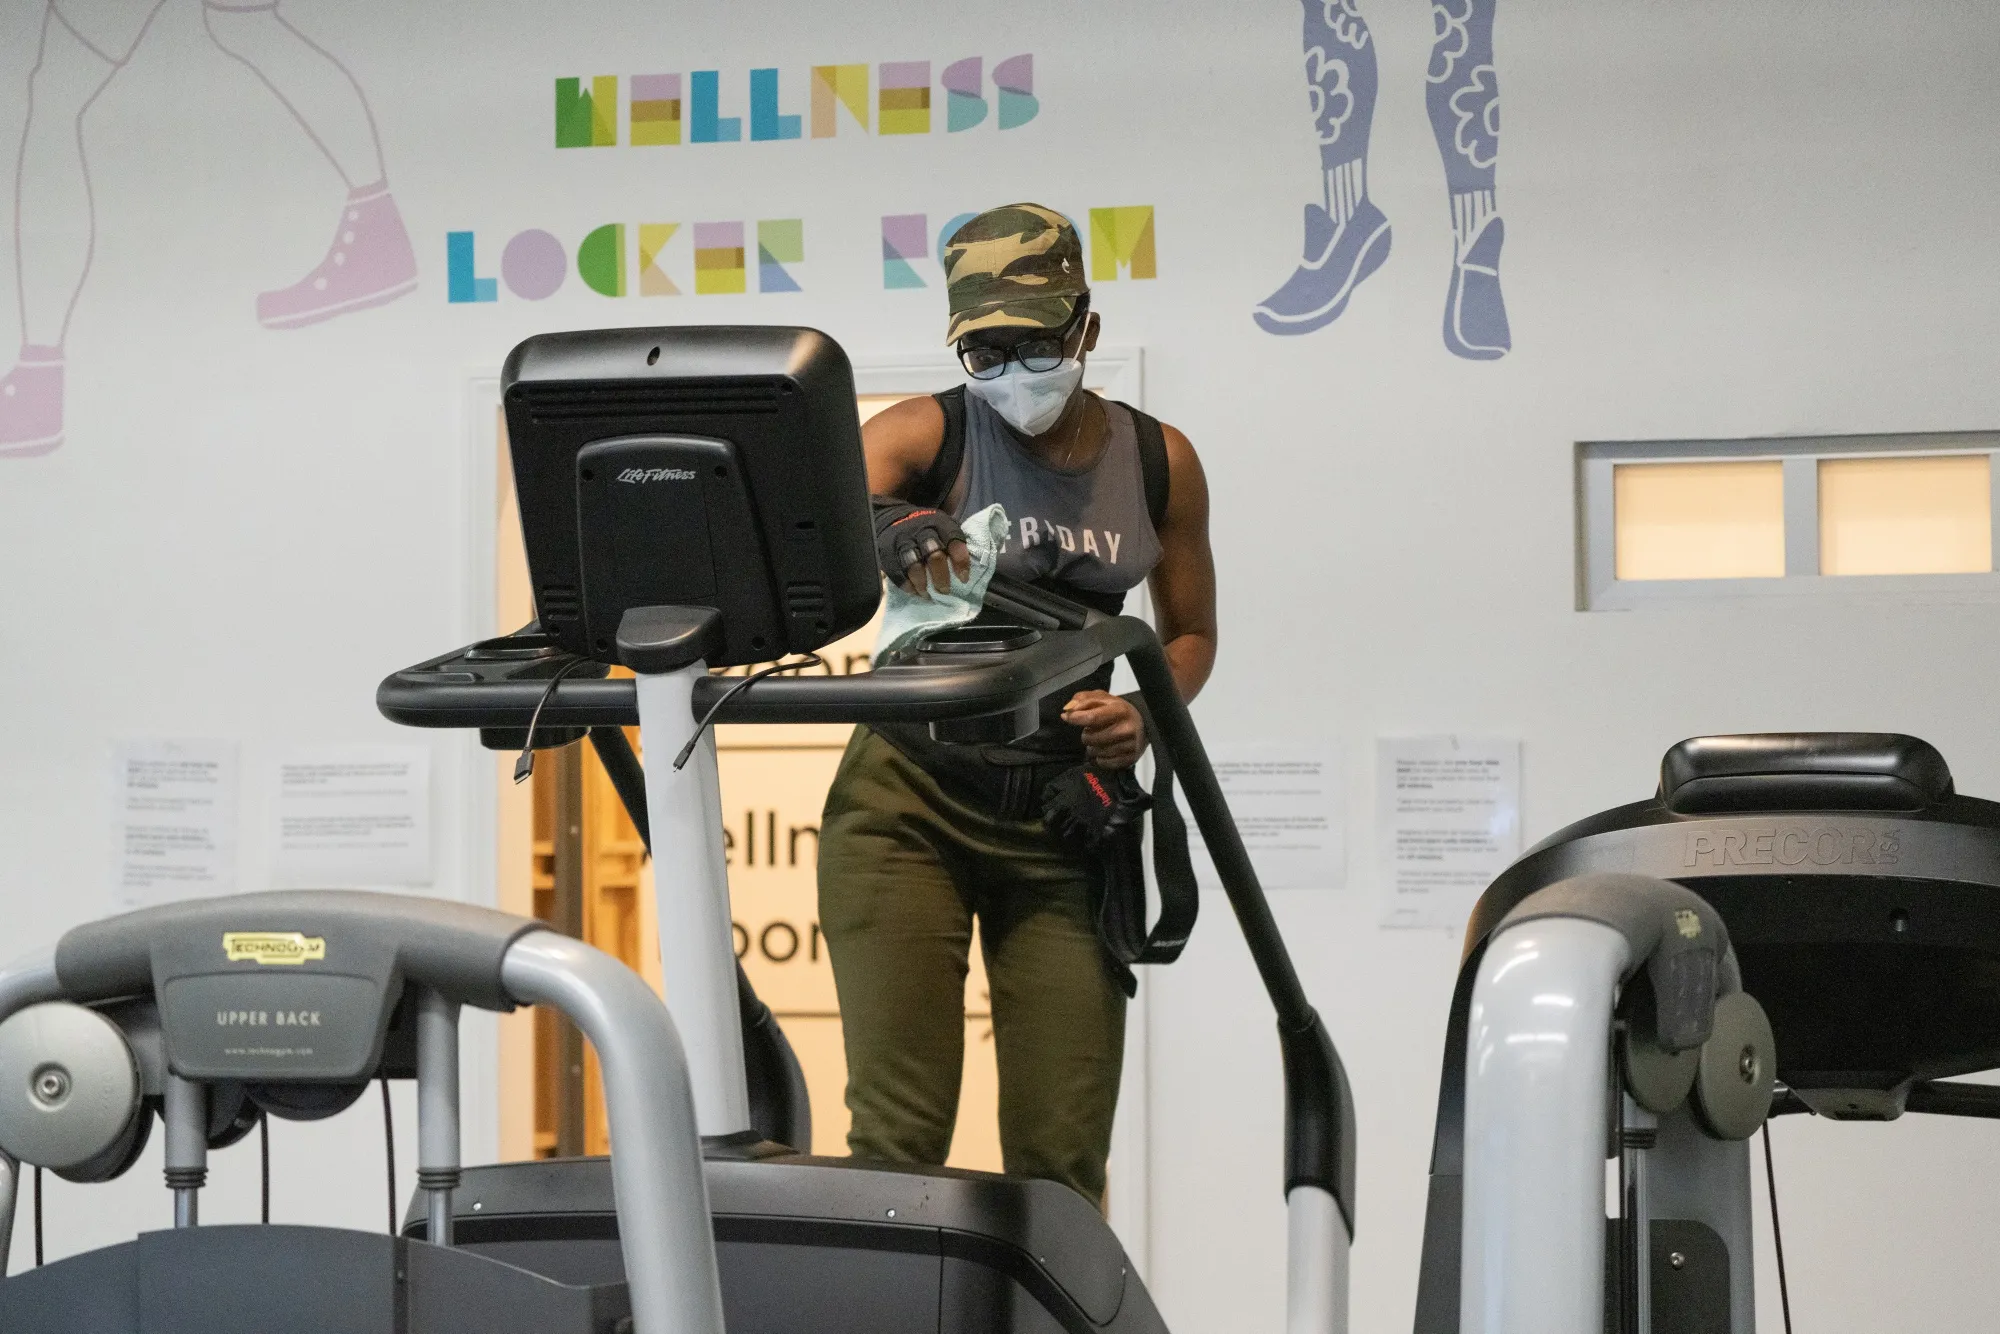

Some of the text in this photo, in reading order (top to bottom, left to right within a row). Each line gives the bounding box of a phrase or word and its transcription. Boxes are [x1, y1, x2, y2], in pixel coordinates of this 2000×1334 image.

[555, 53, 1040, 148] WELLNESS
[447, 205, 1158, 304] LOCKER RM
[1684, 826, 1877, 868] PRECOR
[217, 1010, 320, 1026] UPPER BACK
